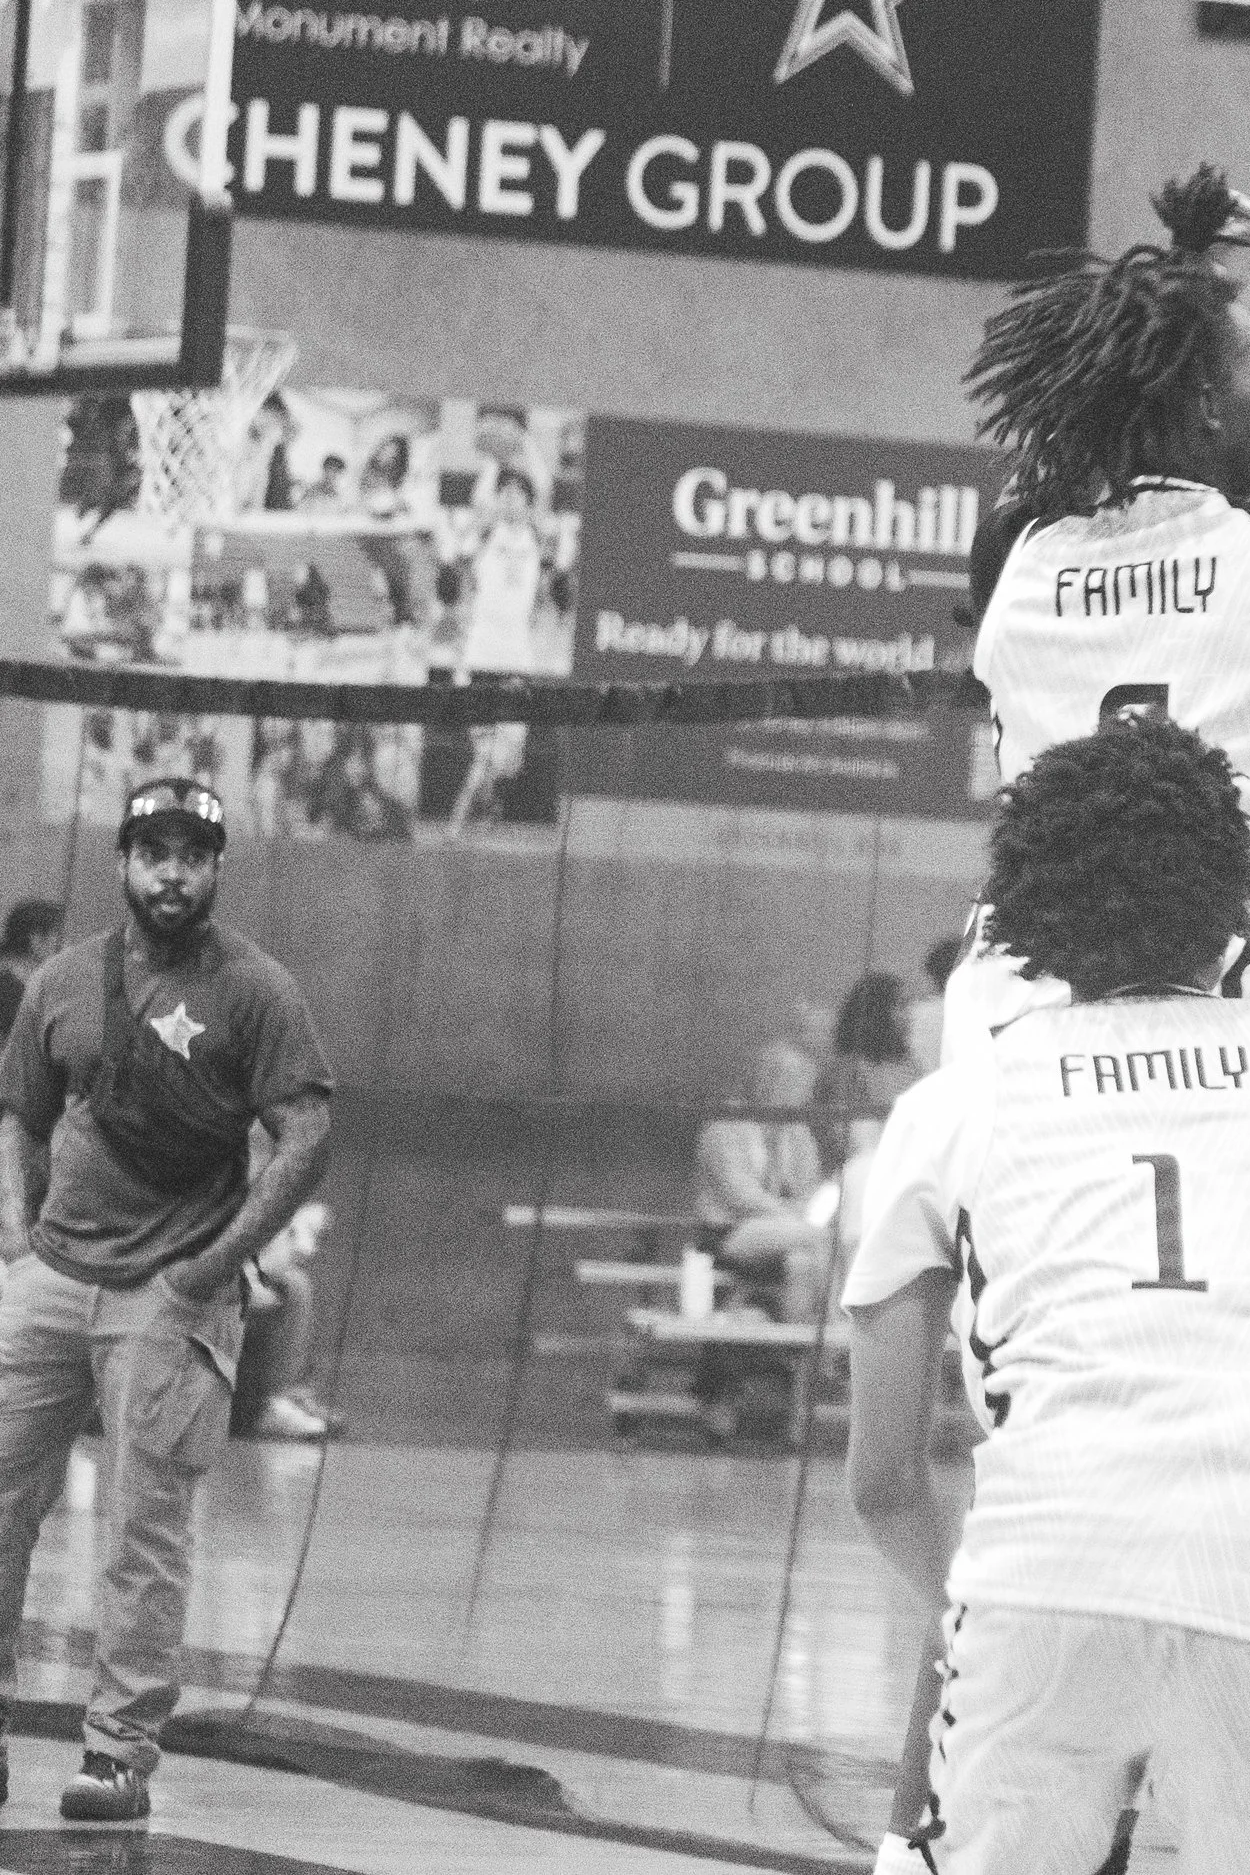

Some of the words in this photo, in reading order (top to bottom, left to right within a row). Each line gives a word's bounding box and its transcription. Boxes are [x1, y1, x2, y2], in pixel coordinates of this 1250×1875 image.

[458, 16, 592, 78] Realty
[163, 94, 608, 221] CHENEY
[625, 132, 1001, 254] GROUP
[670, 465, 980, 558] Greenhill
[747, 547, 907, 593] SCHOOL
[1053, 555, 1219, 617] FAMILY
[595, 609, 709, 668] Ready
[712, 618, 768, 664] for
[770, 623, 829, 667] the
[832, 632, 937, 674] world
[1129, 1152, 1210, 1293] 1
